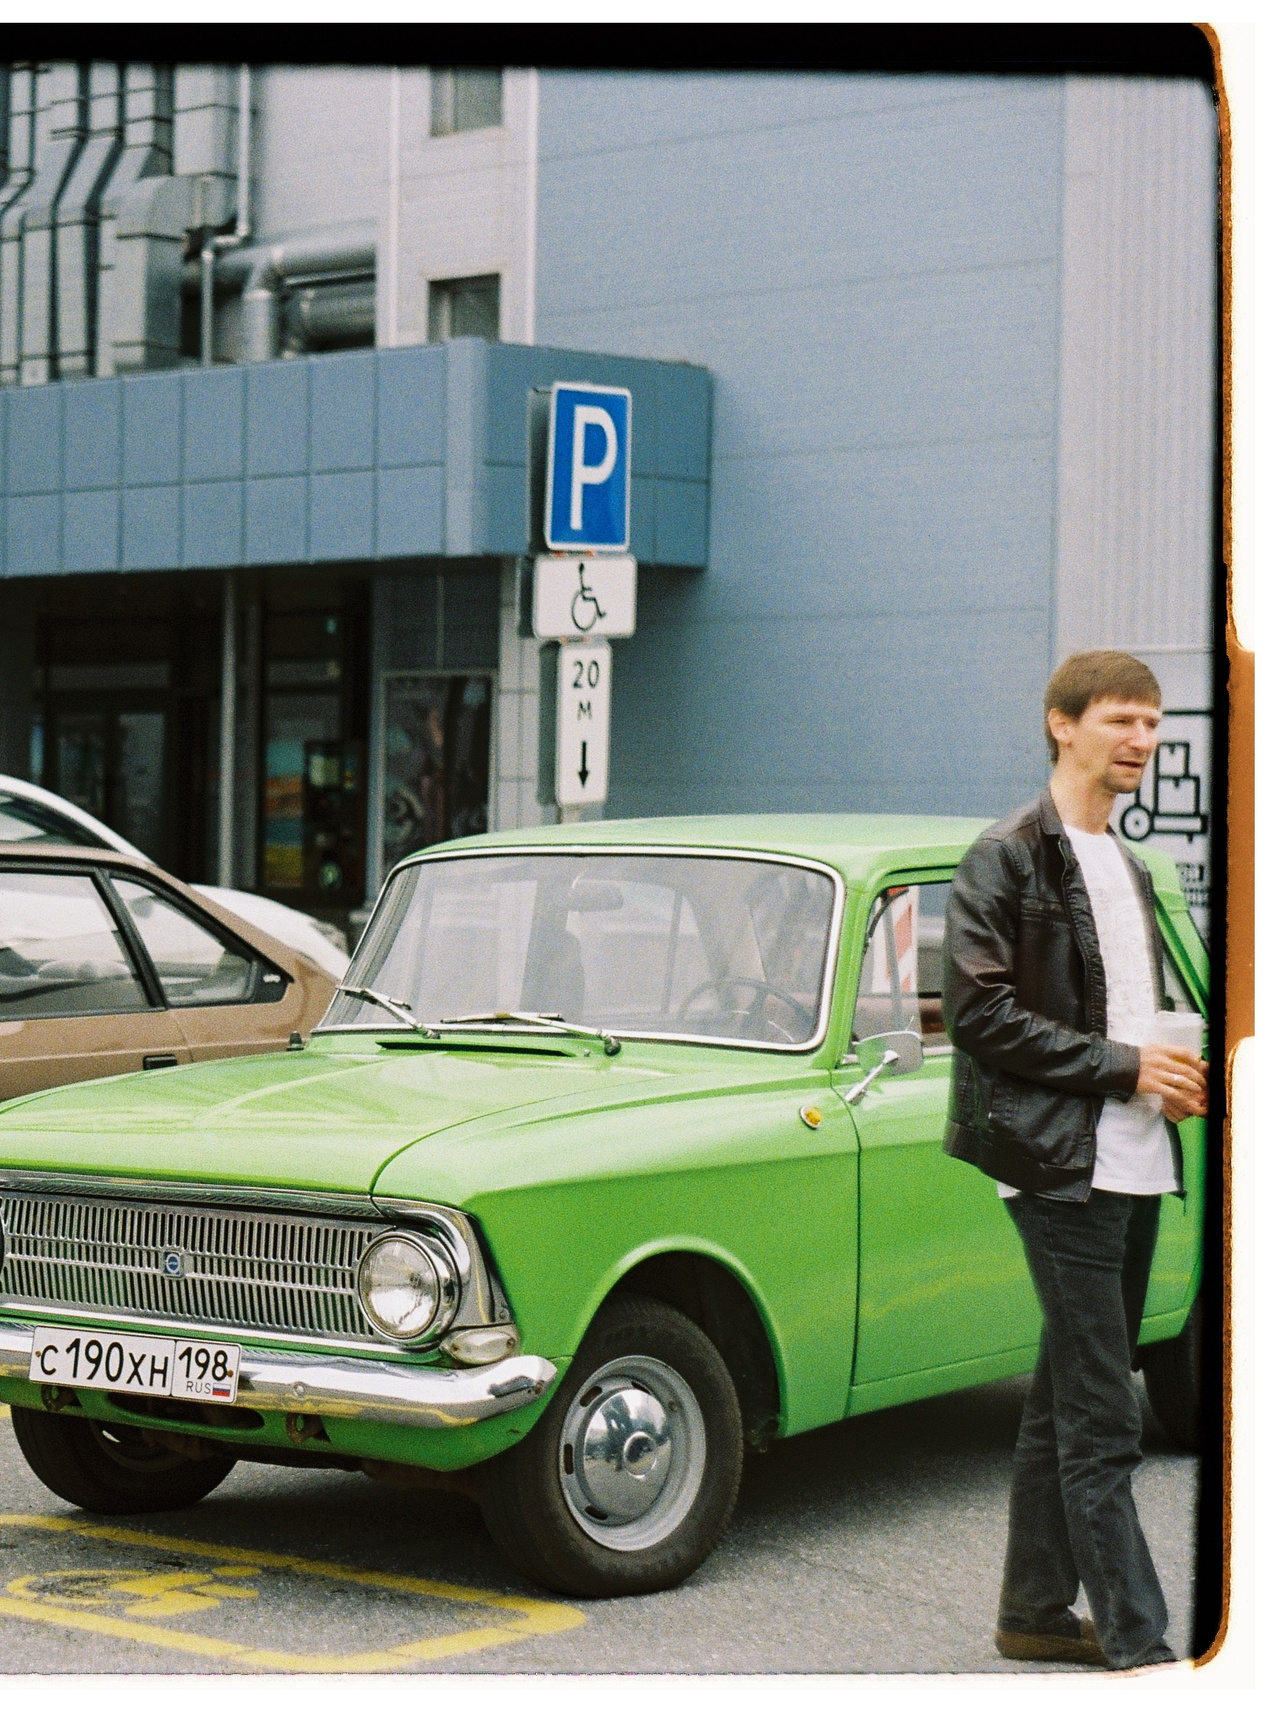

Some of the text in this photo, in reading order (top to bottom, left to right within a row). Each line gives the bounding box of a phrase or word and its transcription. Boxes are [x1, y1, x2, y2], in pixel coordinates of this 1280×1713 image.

[569, 404, 618, 531] P
[572, 660, 600, 689] 20
[178, 1346, 229, 1382] 198
[185, 1380, 212, 1395] RUS
